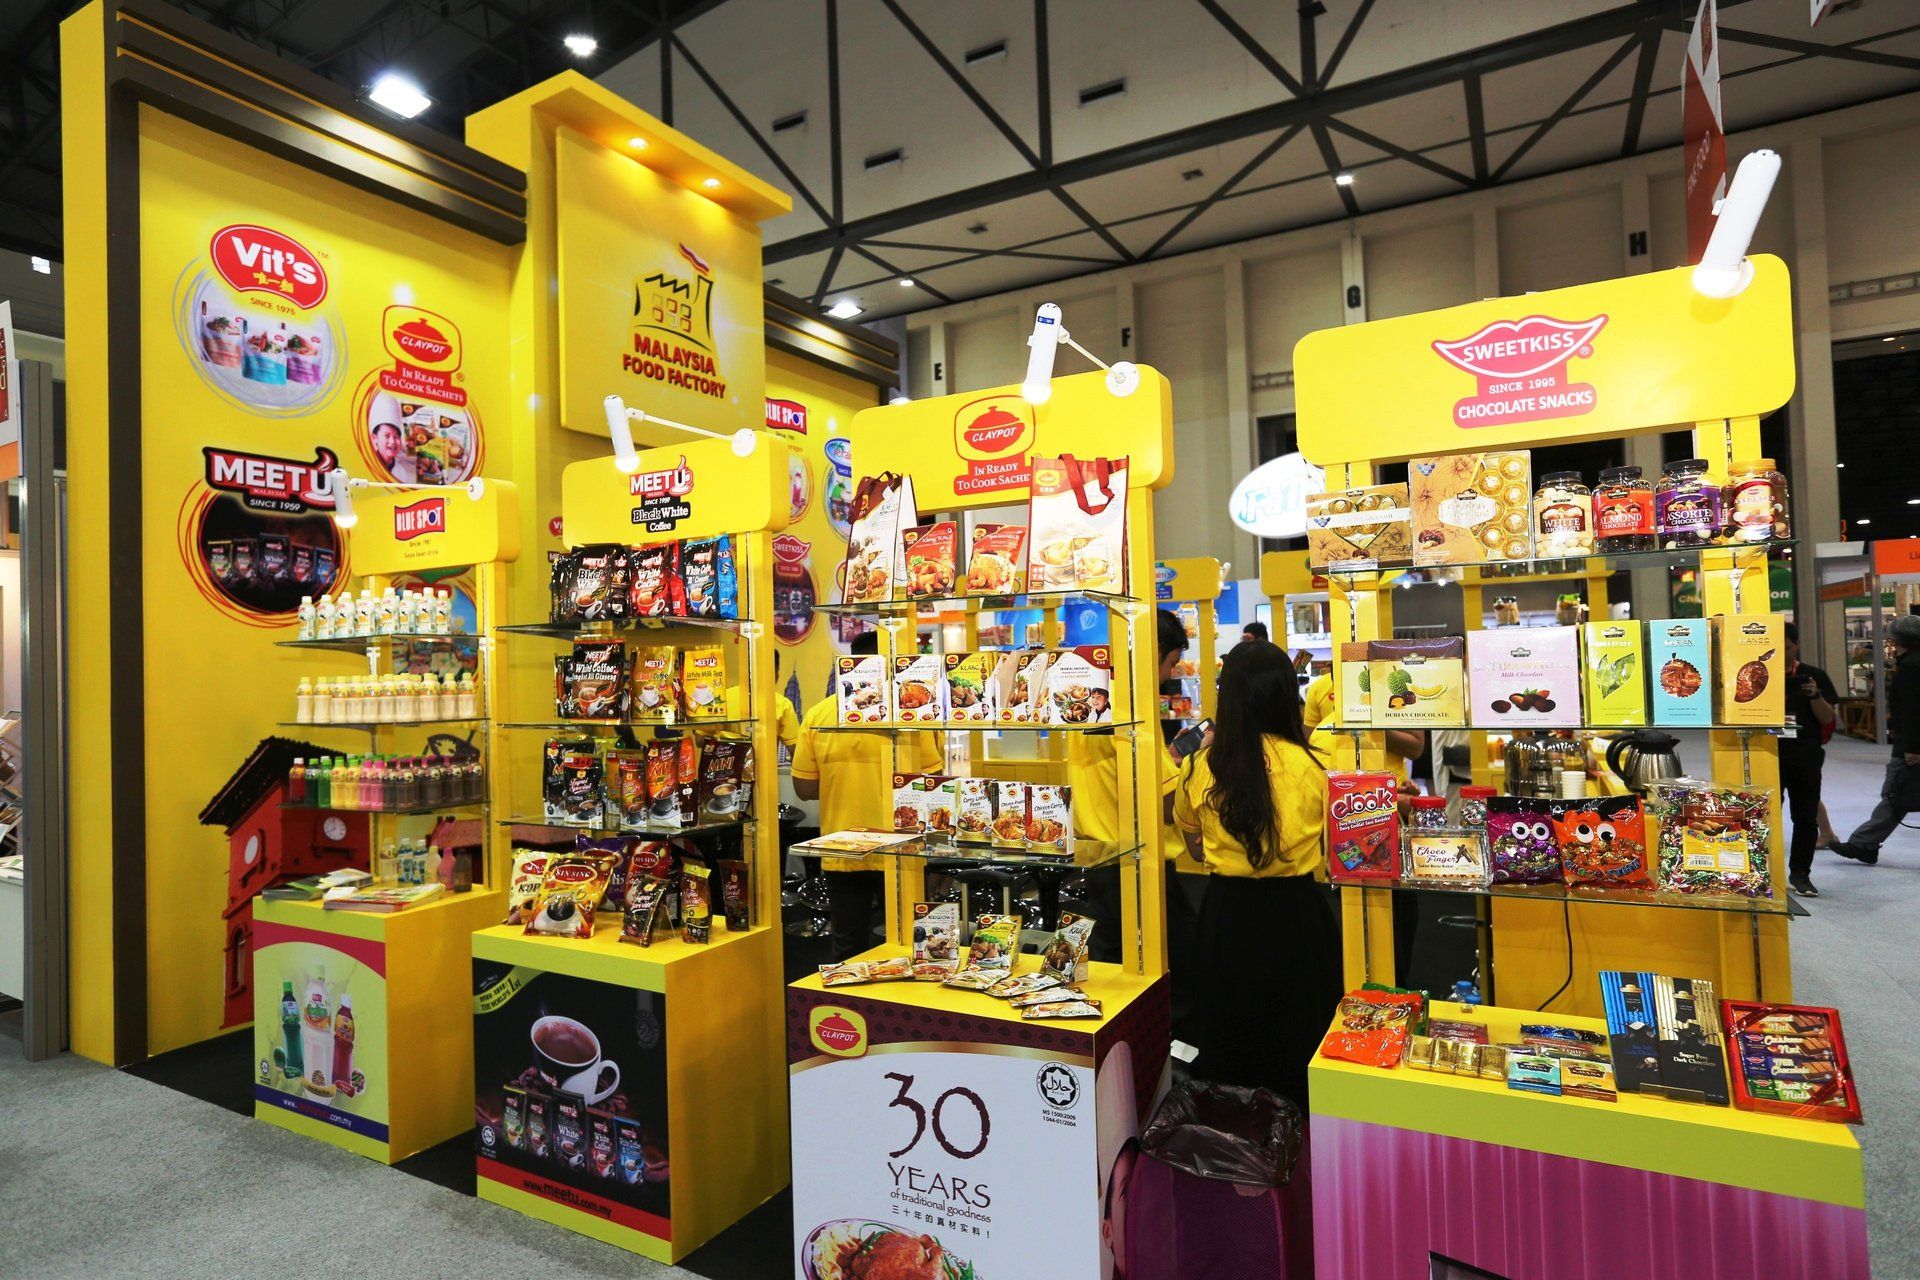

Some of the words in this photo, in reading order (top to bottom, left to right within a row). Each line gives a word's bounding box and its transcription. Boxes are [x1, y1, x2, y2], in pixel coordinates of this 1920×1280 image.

[231, 235, 317, 285] Vit's
[250, 297, 272, 310] SINCE
[276, 304, 296, 316] 1975
[401, 336, 445, 354] CLAYPOT
[1463, 331, 1575, 363] SWEETKISS
[634, 332, 717, 376] MALAYSIA
[623, 354, 665, 380] FOOD
[668, 367, 726, 399] FACTORY
[1489, 381, 1523, 394] SINCE
[1529, 377, 1556, 389] 1995
[1458, 397, 1536, 420] CHOCOLATE
[1538, 390, 1593, 410] SNACKS
[782, 407, 805, 429] SPOT
[971, 426, 1017, 443] CLAYPOT
[998, 473, 1031, 486] SACHE
[253, 488, 287, 498] MALAYSIA
[250, 499, 276, 509] SINCE
[280, 501, 301, 511] 1959
[644, 498, 657, 506] SINCE
[396, 510, 416, 532] BLUE
[416, 506, 442, 530] SPOT
[633, 508, 661, 522] Black
[660, 505, 689, 519] White
[1601, 513, 1642, 525] ALMOND
[1667, 509, 1714, 522] ASSORTED
[649, 521, 672, 532] Coffee
[1544, 517, 1580, 528] WHITE
[774, 543, 804, 553] SWEETKISS
[635, 578, 660, 589] Coffee
[1416, 846, 1447, 855] Choco
[1426, 855, 1456, 863] Finger
[822, 1029, 855, 1043] CLAYPOT
[1679, 1051, 1695, 1059] Sugar
[884, 1071, 991, 1160] 30
[887, 1161, 991, 1208] YEARS
[523, 1179, 612, 1218] www.meetu.com.my
[890, 1187, 901, 1199] of
[902, 1191, 946, 1212] traditional
[947, 1205, 992, 1223] goodness
